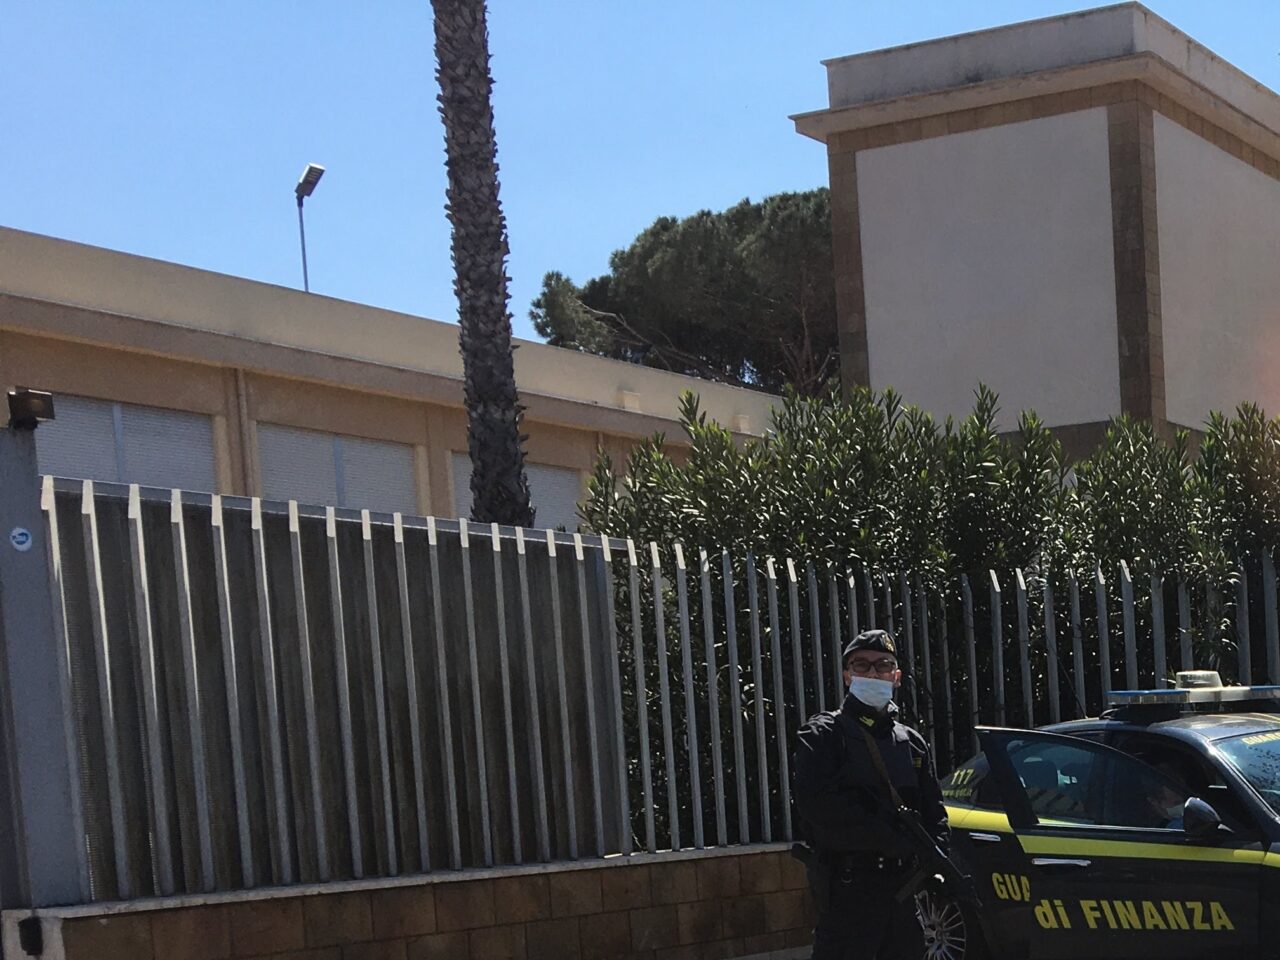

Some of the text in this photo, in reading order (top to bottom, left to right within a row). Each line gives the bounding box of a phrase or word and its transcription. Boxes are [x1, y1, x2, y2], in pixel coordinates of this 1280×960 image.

[951, 768, 975, 785] 117
[1034, 900, 1235, 930] di FINANZA
